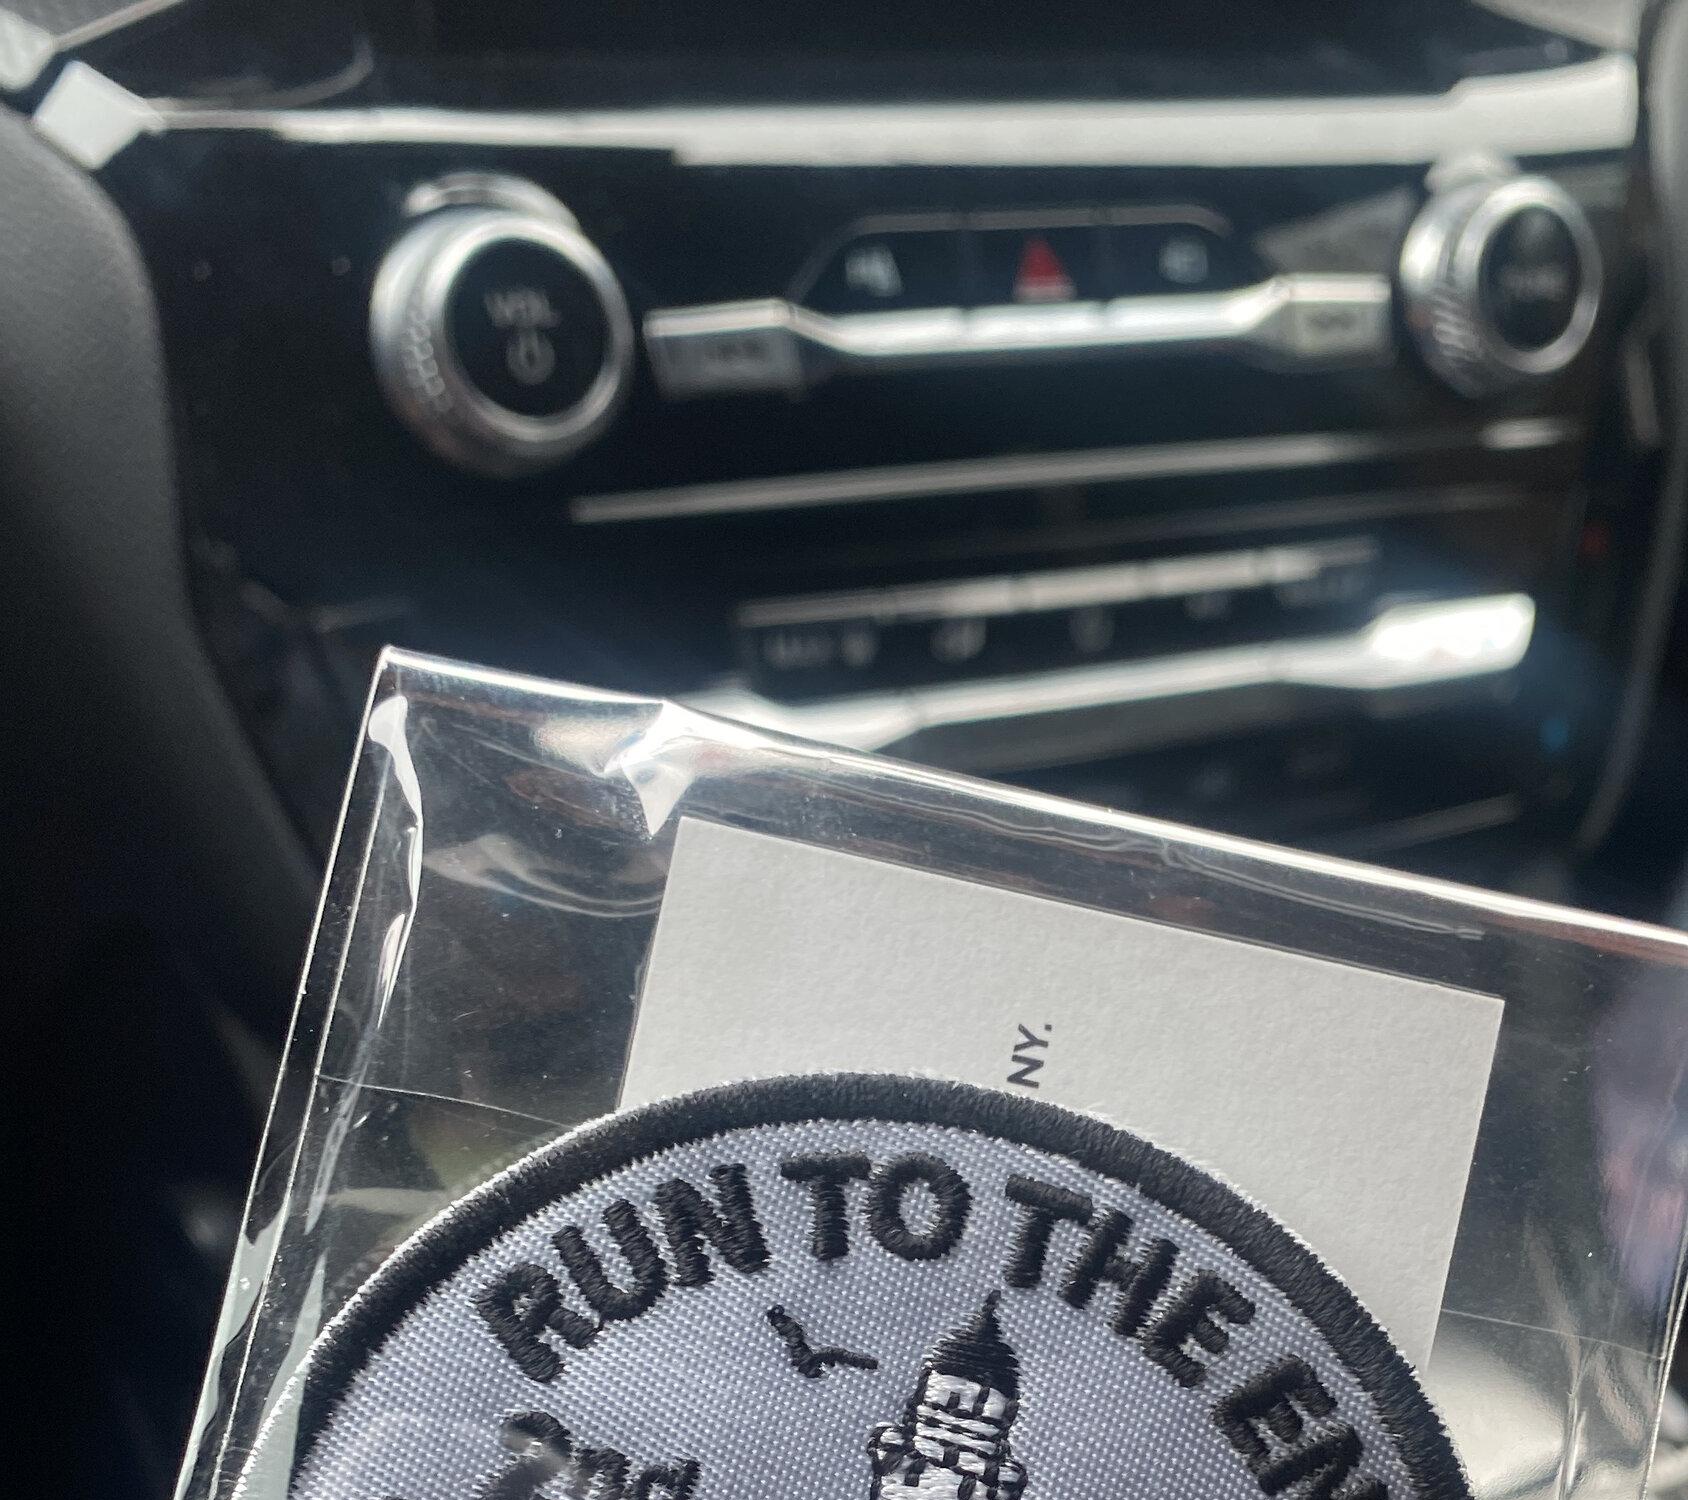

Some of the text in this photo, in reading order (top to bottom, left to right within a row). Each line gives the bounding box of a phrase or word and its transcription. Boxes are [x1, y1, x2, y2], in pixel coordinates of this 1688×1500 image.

[1006, 1023, 1052, 1090] NY.
[475, 1162, 769, 1382] RUN
[780, 1150, 973, 1261] TO
[1005, 1172, 1257, 1388] THE
